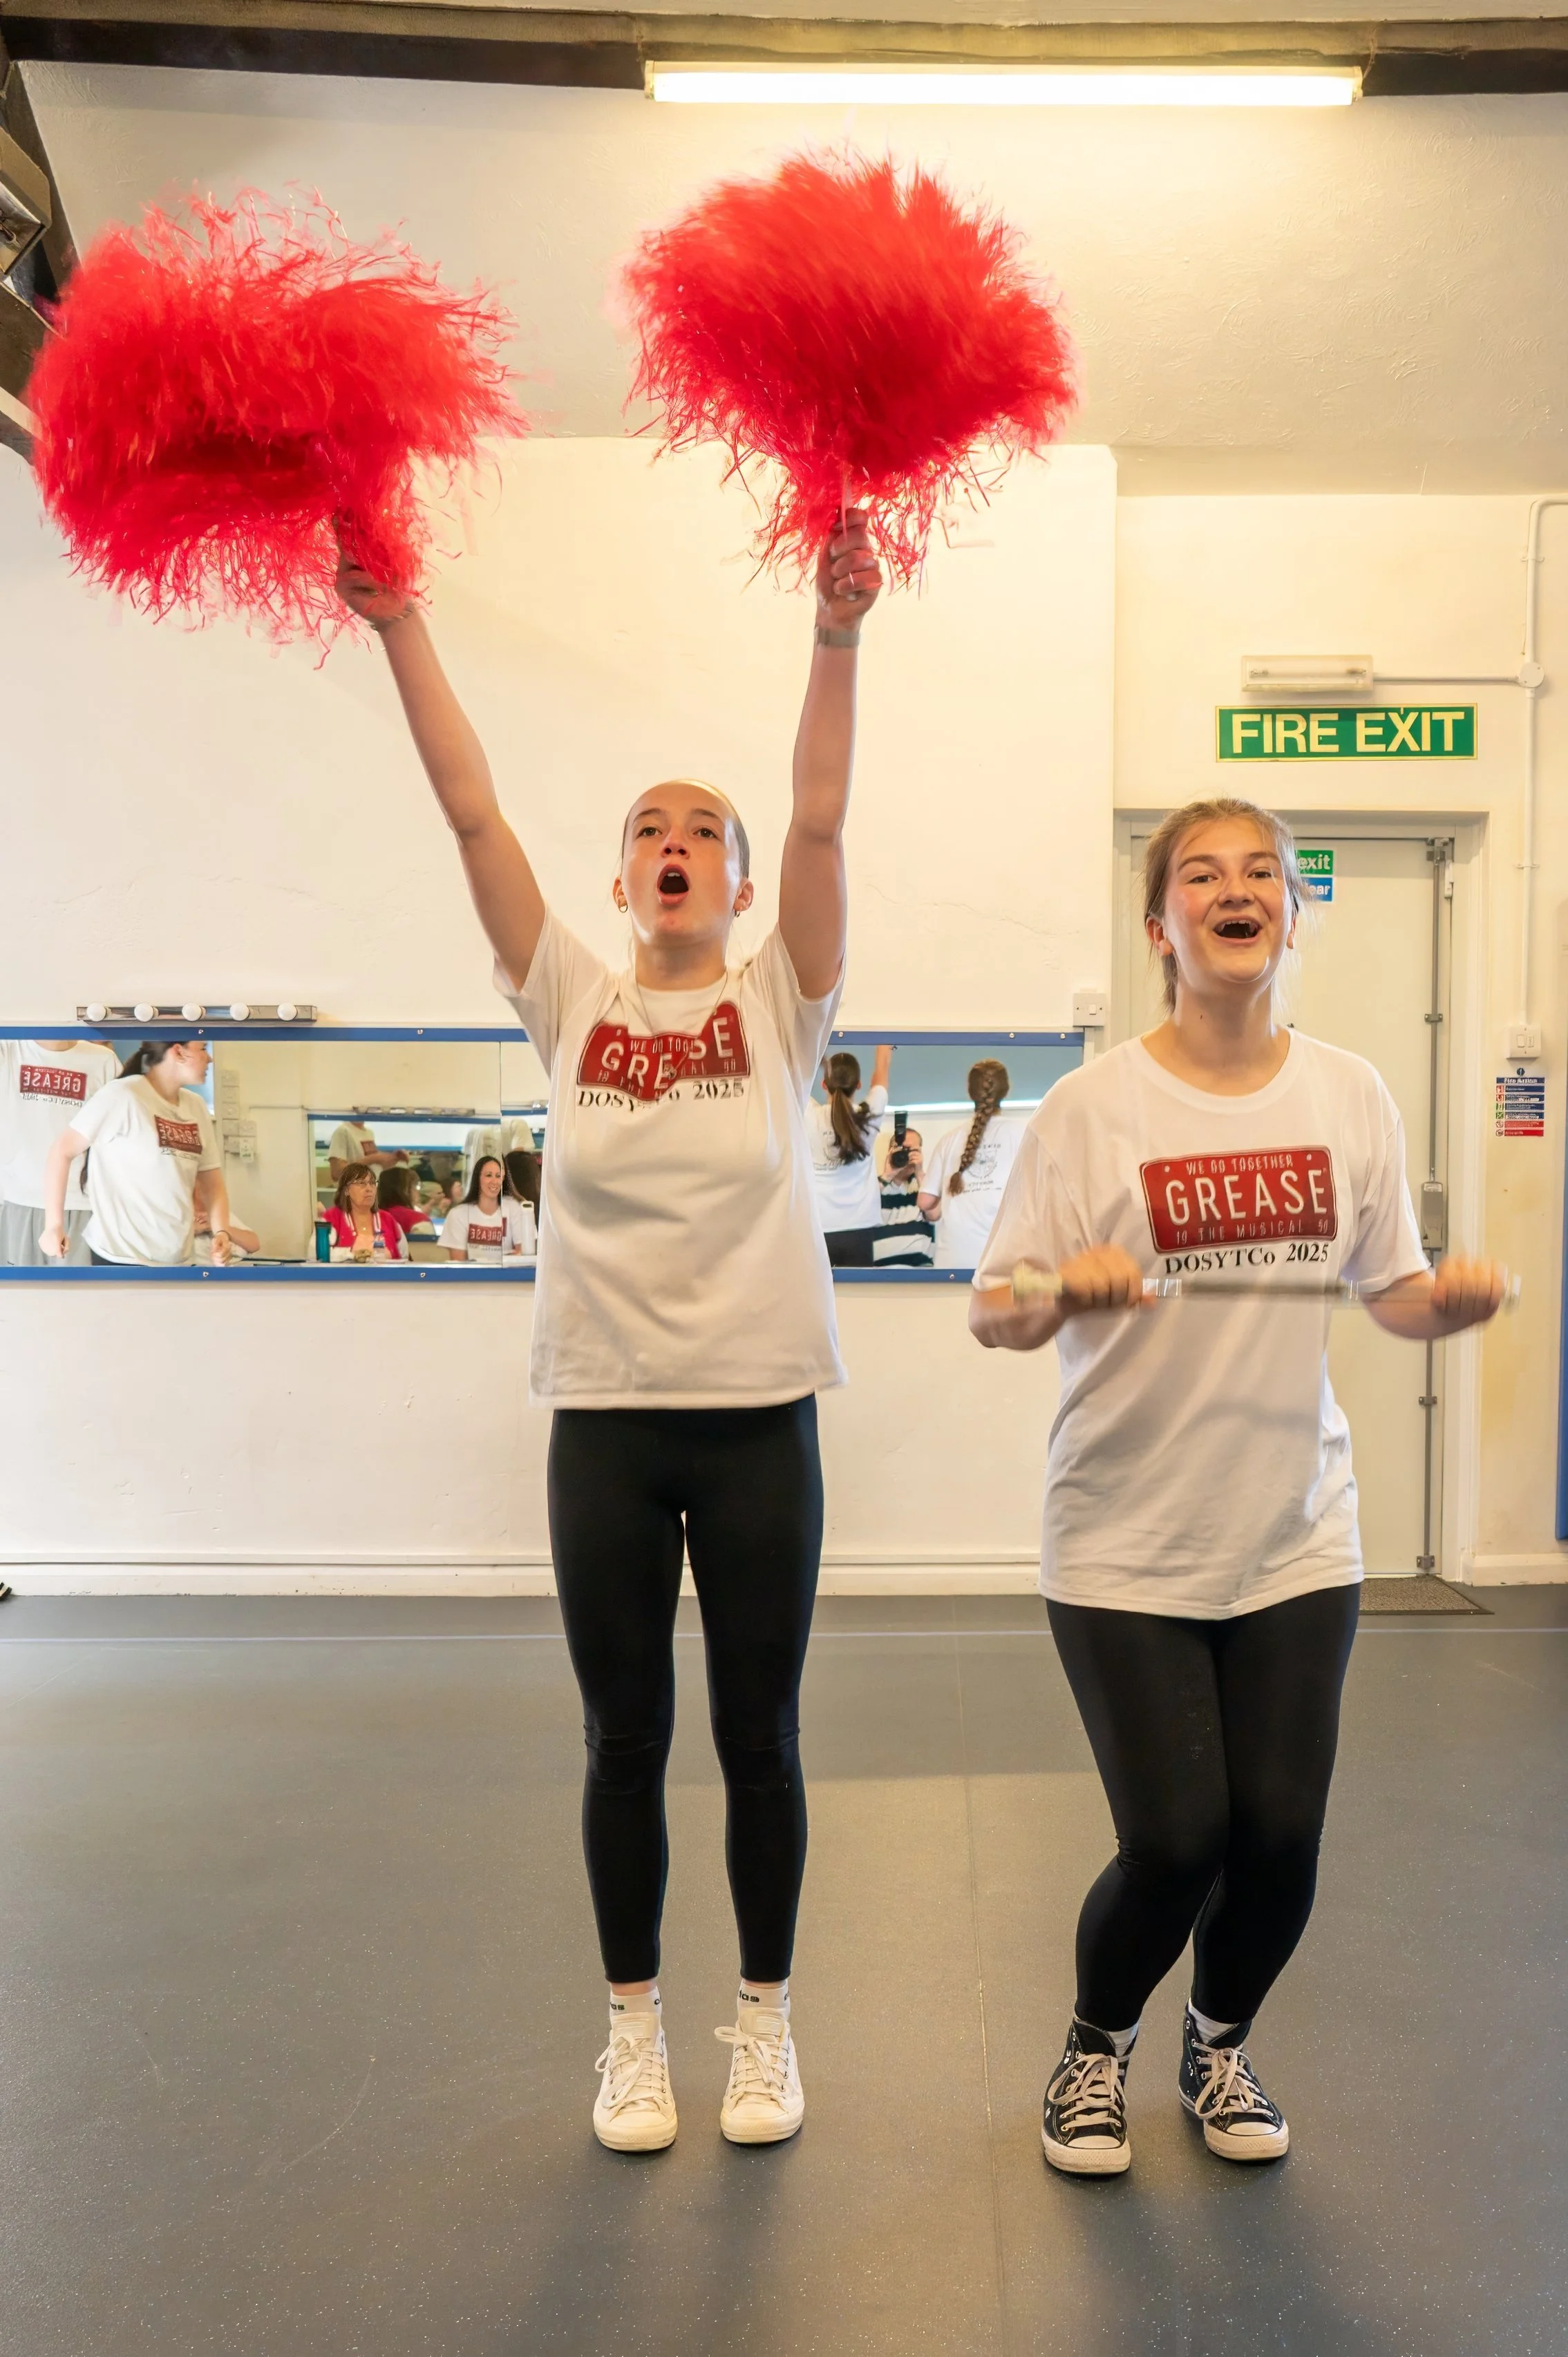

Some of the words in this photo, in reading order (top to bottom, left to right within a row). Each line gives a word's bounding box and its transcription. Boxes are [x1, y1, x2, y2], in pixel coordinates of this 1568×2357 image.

[1232, 713, 1339, 753] FIRE
[1356, 712, 1465, 752] EXIT
[1297, 853, 1331, 870] exit
[601, 1017, 734, 1089] GRESE
[692, 1079, 744, 1100] 2025
[1186, 1161, 1205, 1175] WE
[1211, 1158, 1225, 1174] GO
[1231, 1154, 1293, 1172] TOGETHER
[1165, 1170, 1327, 1226] GREASE
[1177, 1230, 1187, 1245] 19
[1198, 1226, 1225, 1241] THE
[1237, 1219, 1303, 1238] MUSICAL
[1165, 1248, 1276, 1275] DOSYTCo
[1286, 1243, 1329, 1262] 2025
